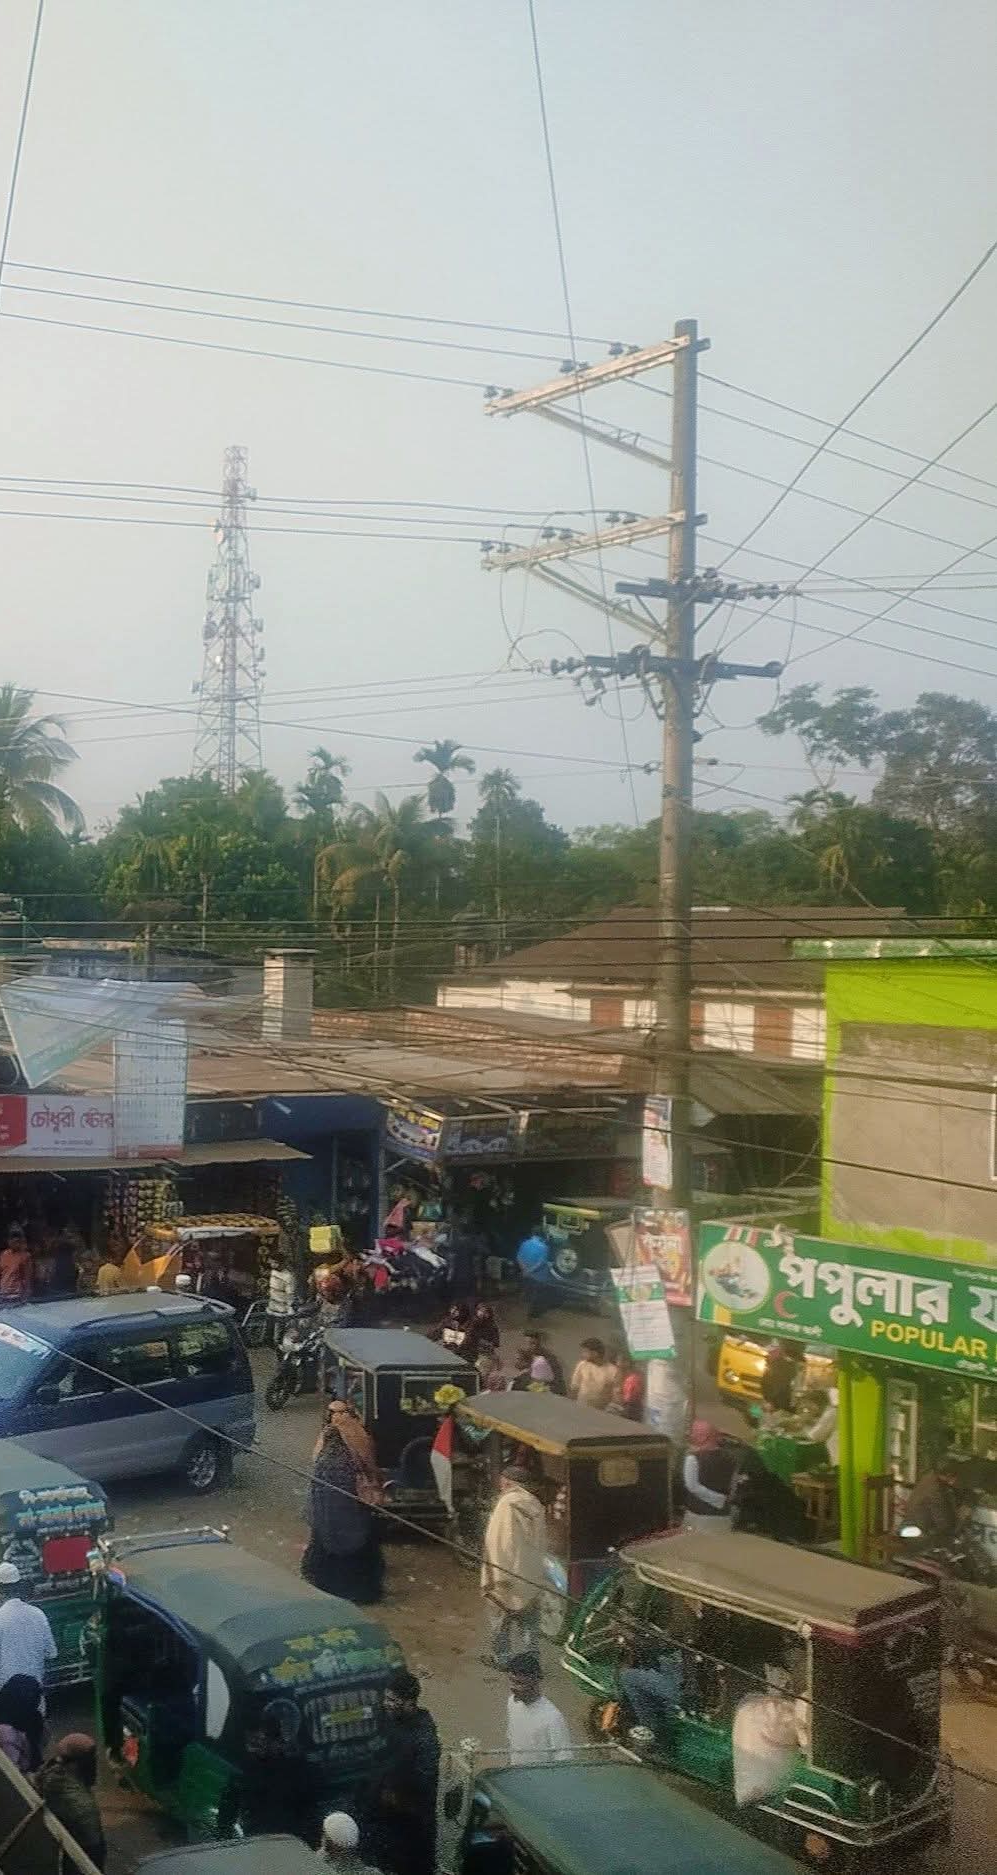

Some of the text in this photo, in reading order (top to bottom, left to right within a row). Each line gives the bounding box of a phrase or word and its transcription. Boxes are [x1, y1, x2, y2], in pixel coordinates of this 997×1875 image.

[30, 1103, 75, 1133] চৌধুরী
[779, 1253, 953, 1328] পপুলার
[870, 1319, 988, 1358] POPULAR
